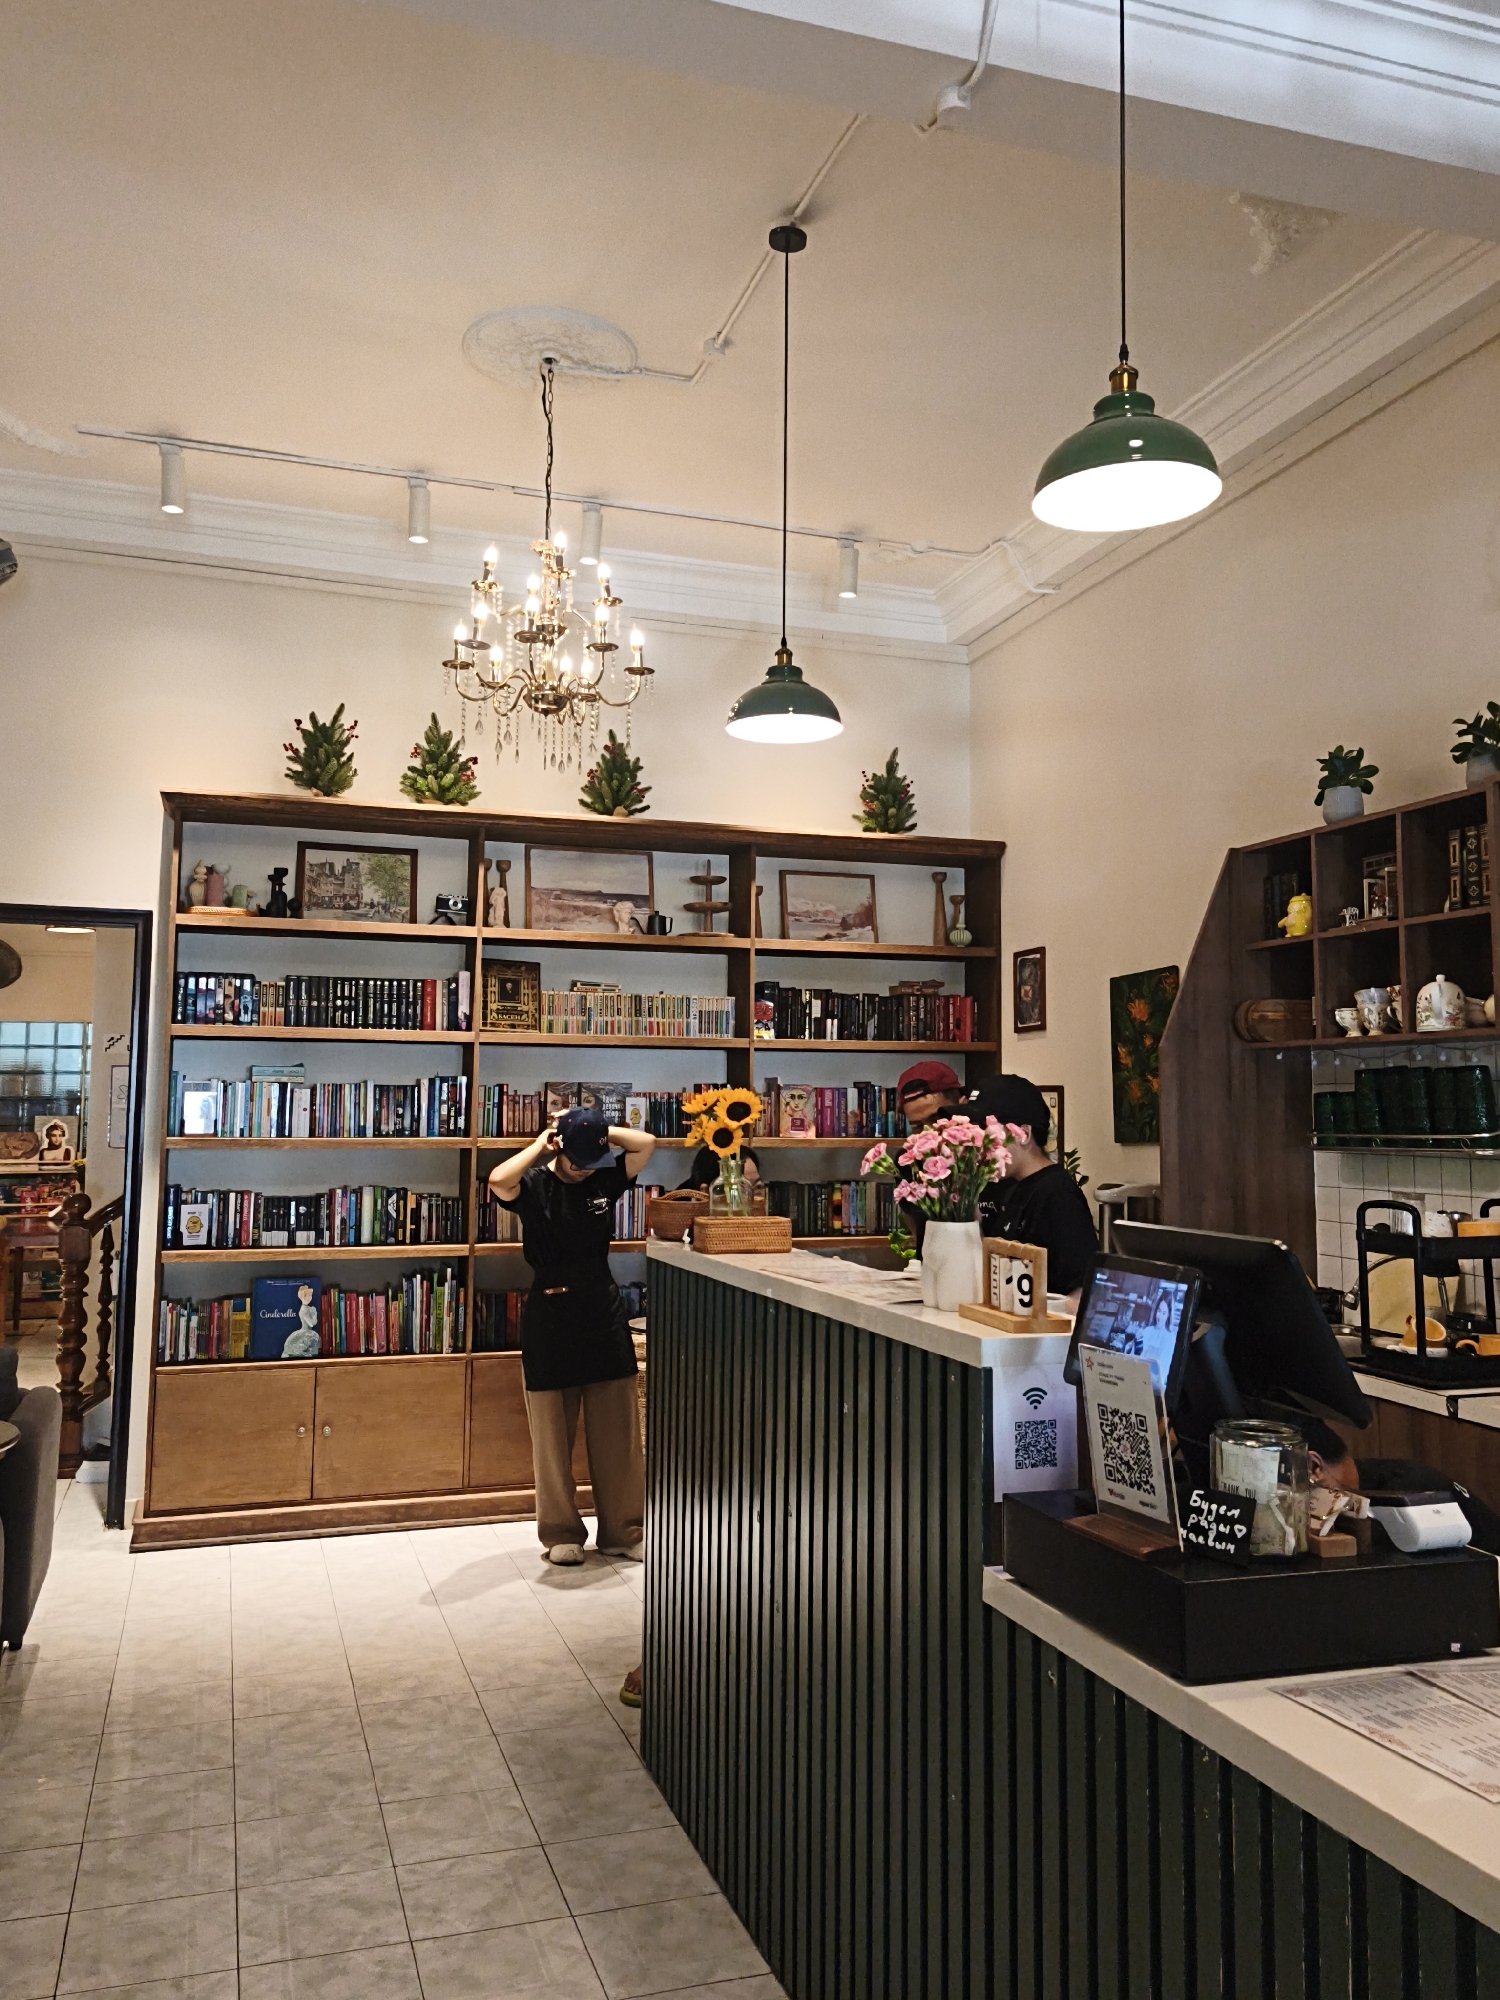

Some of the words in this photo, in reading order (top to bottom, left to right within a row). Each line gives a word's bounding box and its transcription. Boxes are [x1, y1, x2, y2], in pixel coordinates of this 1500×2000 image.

[259, 1308, 297, 1319] Cinderella
[1189, 1490, 1241, 1521] Будем
[1187, 1513, 1231, 1536] рады
